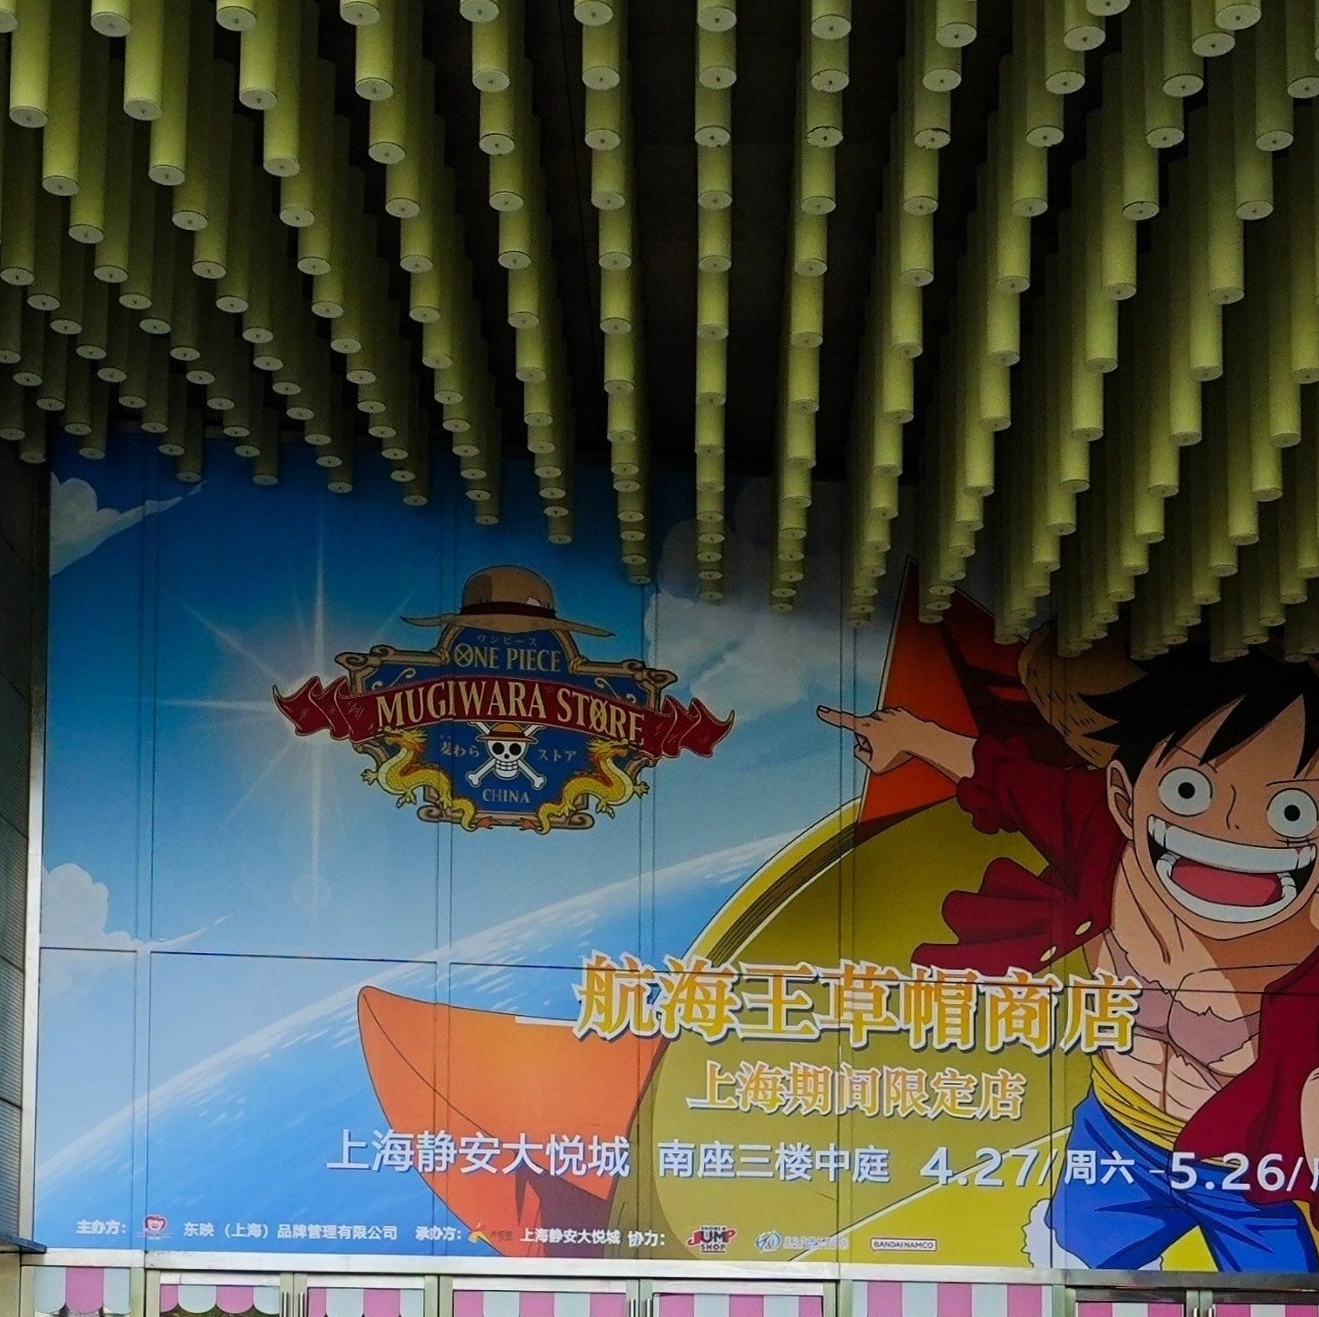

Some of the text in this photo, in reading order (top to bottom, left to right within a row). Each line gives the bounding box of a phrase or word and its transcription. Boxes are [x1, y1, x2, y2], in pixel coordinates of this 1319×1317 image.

[453, 643, 562, 672] ONE PIECE
[377, 679, 647, 743] MUGIWARA STORE
[439, 741, 578, 762] 麦わら ストア
[482, 788, 530, 804] CHINA
[572, 950, 1144, 1054] 航海王草帽商店
[685, 1060, 1027, 1120] 上海期间限定店
[326, 1128, 631, 1178] 上海静安大悦城
[657, 1140, 891, 1184] 南座三楼中庭
[520, 1227, 621, 1245] 上海静安大悦城
[688, 1229, 737, 1246] JUMP
